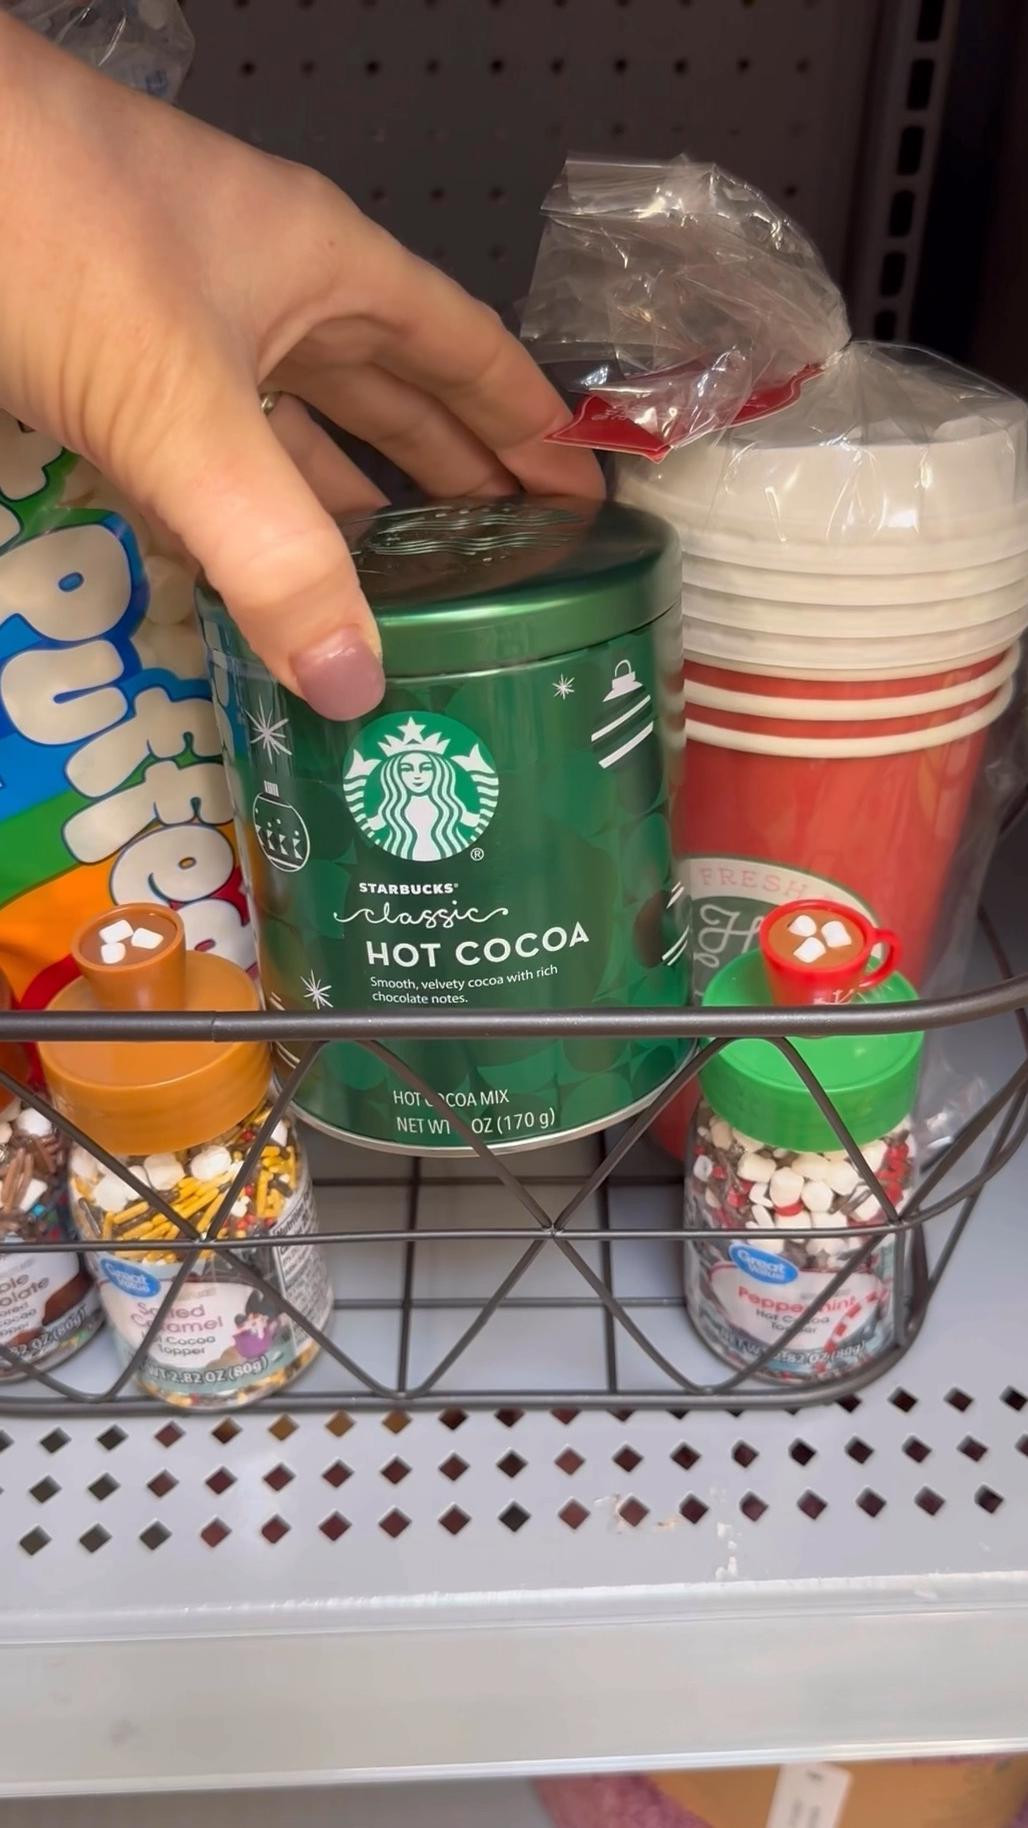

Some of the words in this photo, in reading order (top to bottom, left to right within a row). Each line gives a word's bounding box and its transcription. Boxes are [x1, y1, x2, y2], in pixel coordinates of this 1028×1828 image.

[333, 900, 509, 929] classic
[366, 941, 441, 967] HOT
[455, 921, 590, 966] COCOA
[370, 976, 419, 990] Smooth,
[421, 978, 465, 991] velvety
[468, 976, 504, 988] cocoa
[507, 969, 534, 983] with
[536, 964, 558, 977] rich
[372, 991, 429, 1004] chocolate
[431, 994, 468, 1004] notes.
[393, 1090, 421, 1106] HOT
[480, 1089, 510, 1106] MIX
[396, 1117, 424, 1133] NET
[471, 1117, 493, 1134] OZ
[497, 1111, 535, 1134] (170
[539, 1107, 555, 1129] g)
